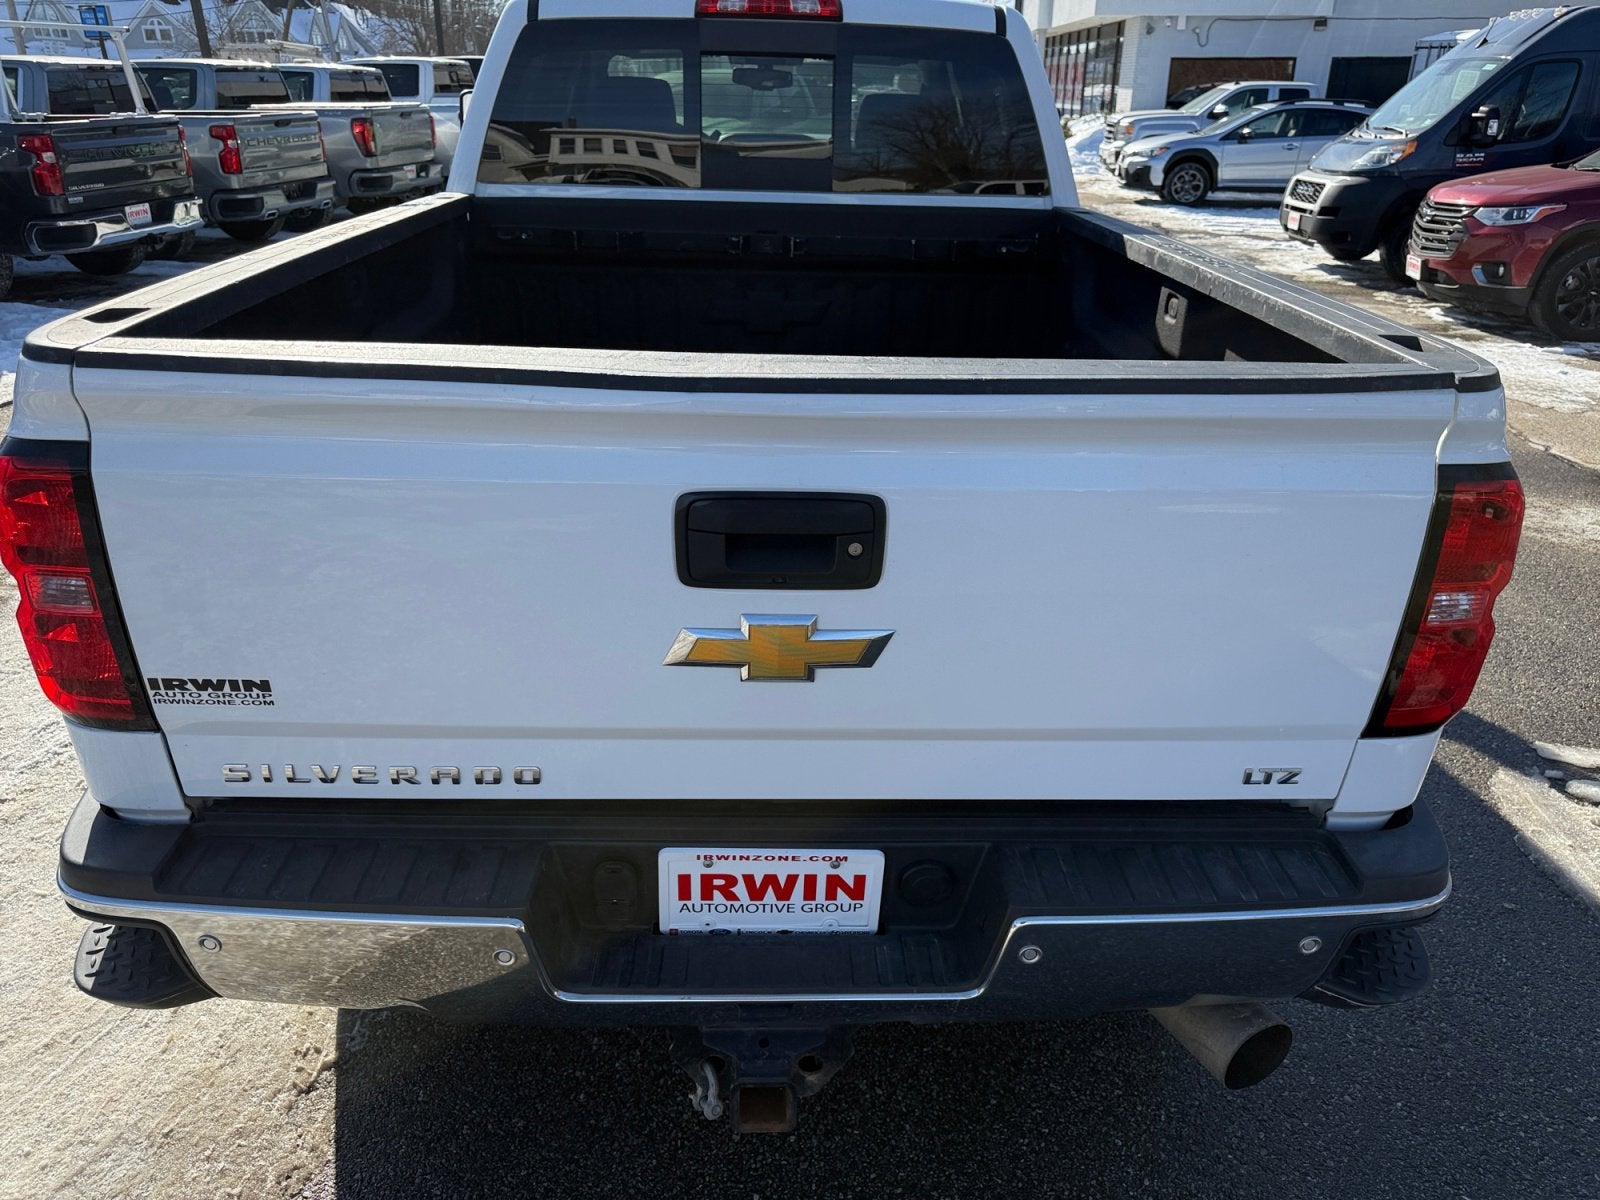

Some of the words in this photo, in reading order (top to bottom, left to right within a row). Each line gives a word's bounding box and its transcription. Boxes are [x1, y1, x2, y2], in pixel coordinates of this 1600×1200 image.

[127, 208, 149, 219] IRWIN
[147, 677, 272, 692] IRWIN
[153, 698, 275, 706] IRWINZONE.COM
[222, 763, 542, 785] SILVERADO
[1242, 767, 1303, 785] LTZ
[696, 854, 849, 862] IRWINZONE.COM
[677, 873, 867, 902] IRWIN
[679, 902, 796, 914] AUTOMOTIVE
[801, 902, 864, 913] GROUP
